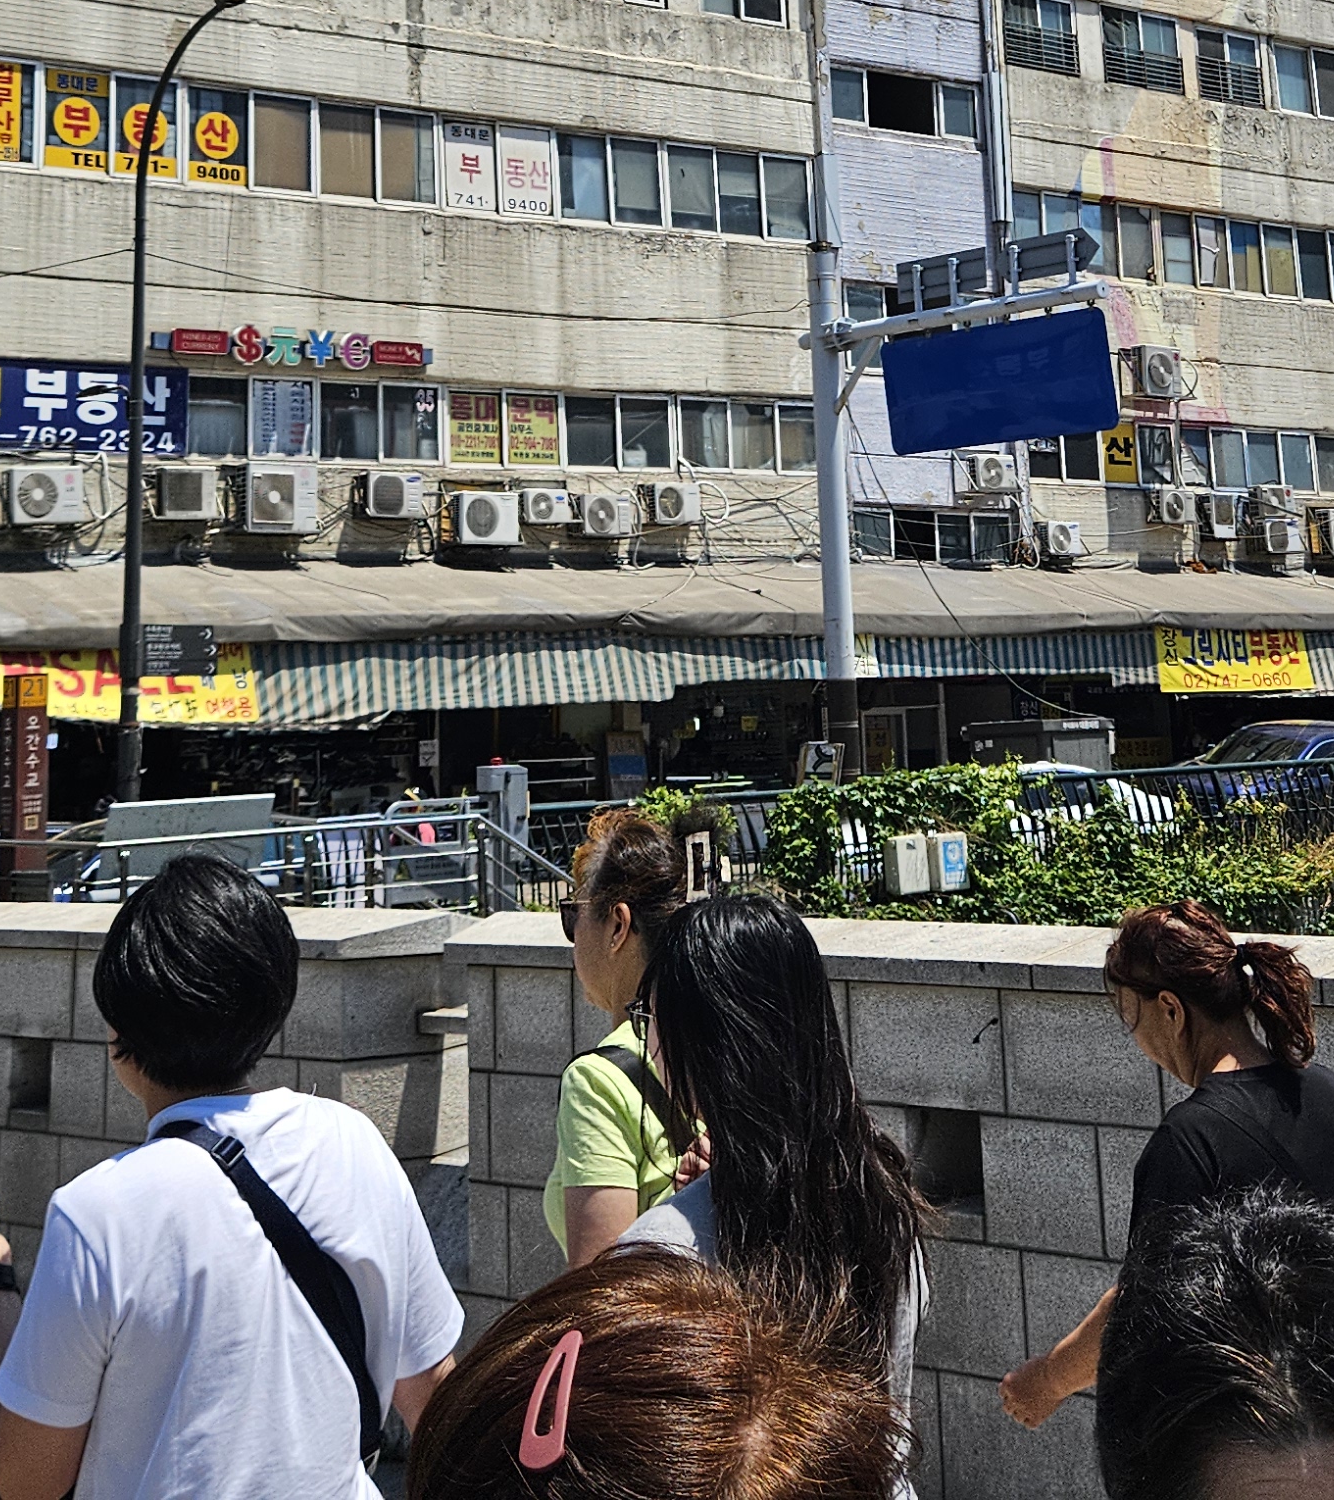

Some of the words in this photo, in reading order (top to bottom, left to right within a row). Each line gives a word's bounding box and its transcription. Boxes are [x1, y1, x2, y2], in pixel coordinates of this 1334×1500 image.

[57, 73, 89, 93] 동대문
[451, 125, 490, 141] 동대문
[71, 151, 104, 169] TEL
[196, 166, 241, 182] 9400
[508, 198, 548, 212] 9400
[23, 368, 171, 426] 부동산
[1105, 436, 1134, 467] 산
[1249, 628, 1300, 666] 부동산
[23, 678, 44, 697] 21
[1183, 671, 1292, 690] 02)747-0660
[24, 715, 41, 787] 오간수교
